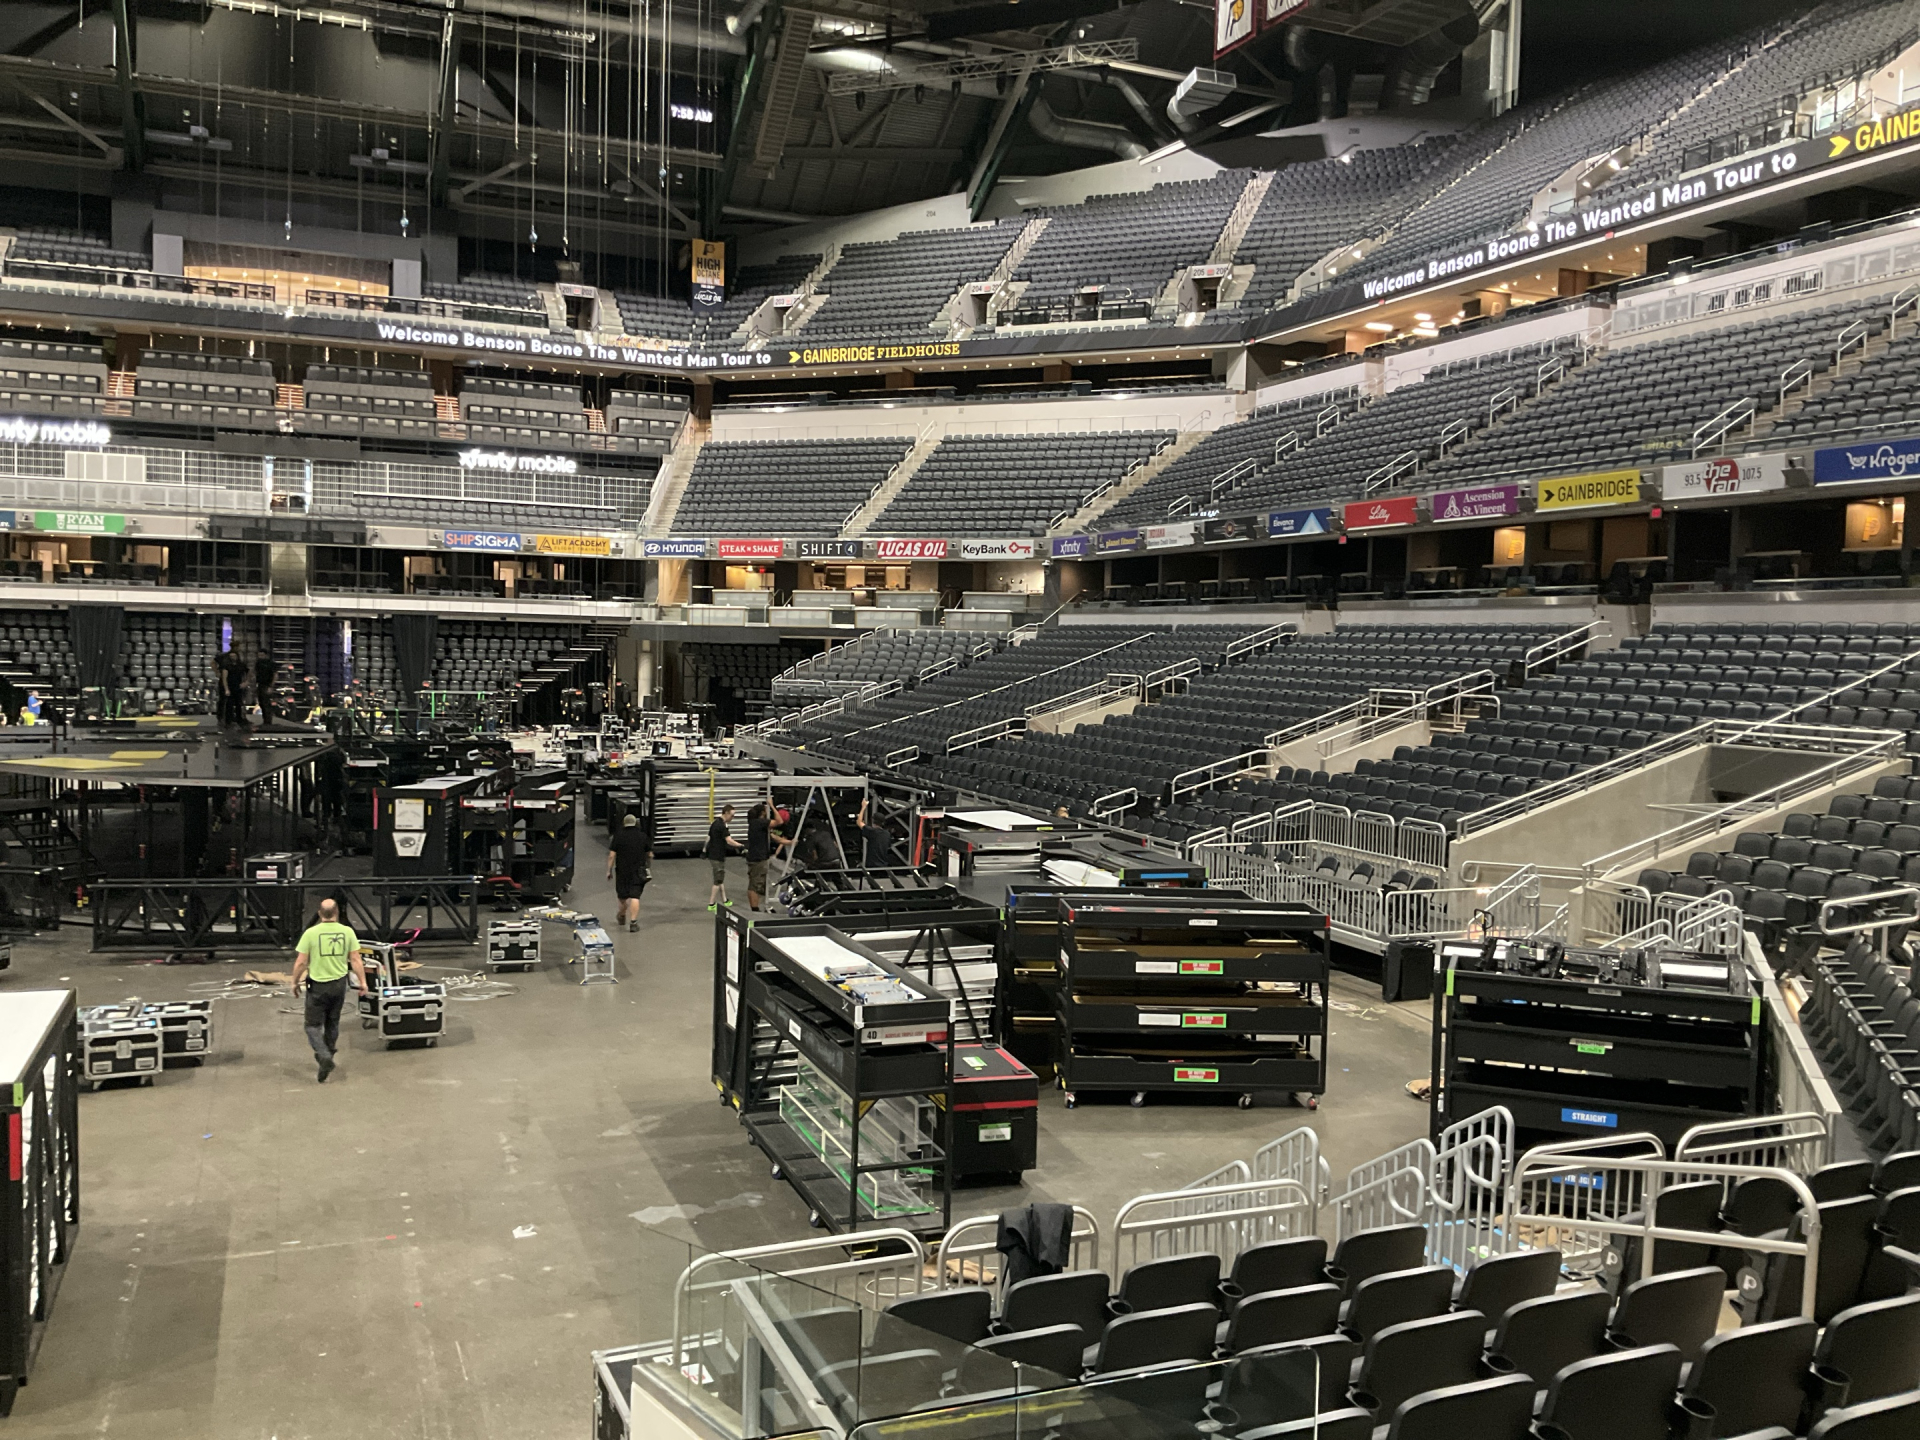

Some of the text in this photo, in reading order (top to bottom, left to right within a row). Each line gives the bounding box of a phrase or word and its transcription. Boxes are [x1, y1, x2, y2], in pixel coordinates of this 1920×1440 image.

[670, 104, 713, 123] 7:58 AM
[1363, 152, 1797, 299] Welcome Benson Boone The Wanted Man Tour to
[696, 257, 720, 270] HIGH
[696, 269, 720, 279] OCTANE
[694, 293, 712, 301] LUCAS
[378, 324, 771, 367] Welcome Benson Boone The Wanted Man Tour to
[803, 343, 960, 363] GAINBRIDGE FIELDHOUSE
[41, 420, 111, 444] mobile
[458, 448, 577, 473] xfinity mobile
[1869, 445, 1920, 476] Kroger
[1684, 462, 1762, 493] 93.5 the fan 107.5
[1463, 490, 1505, 503] Ascension
[1557, 478, 1634, 502] GAINBRIDGE
[66, 514, 105, 525] RYAN
[1368, 504, 1391, 522] Lilly
[1273, 519, 1295, 527] Elevance
[446, 533, 519, 548] SHIPSIGMA
[551, 538, 607, 548] LIFT ACADEMY
[662, 543, 705, 553] HYUNDAI
[720, 544, 746, 553] STEAK
[752, 545, 779, 553] SHAKE
[801, 543, 854, 555] SHIFT 4
[877, 542, 946, 556] LUCAS OIL
[962, 544, 1007, 556] KeyBank
[1060, 541, 1081, 555] xfinity
[867, 1030, 878, 1040] 4D
[1572, 1112, 1607, 1123] STRAIGHT
